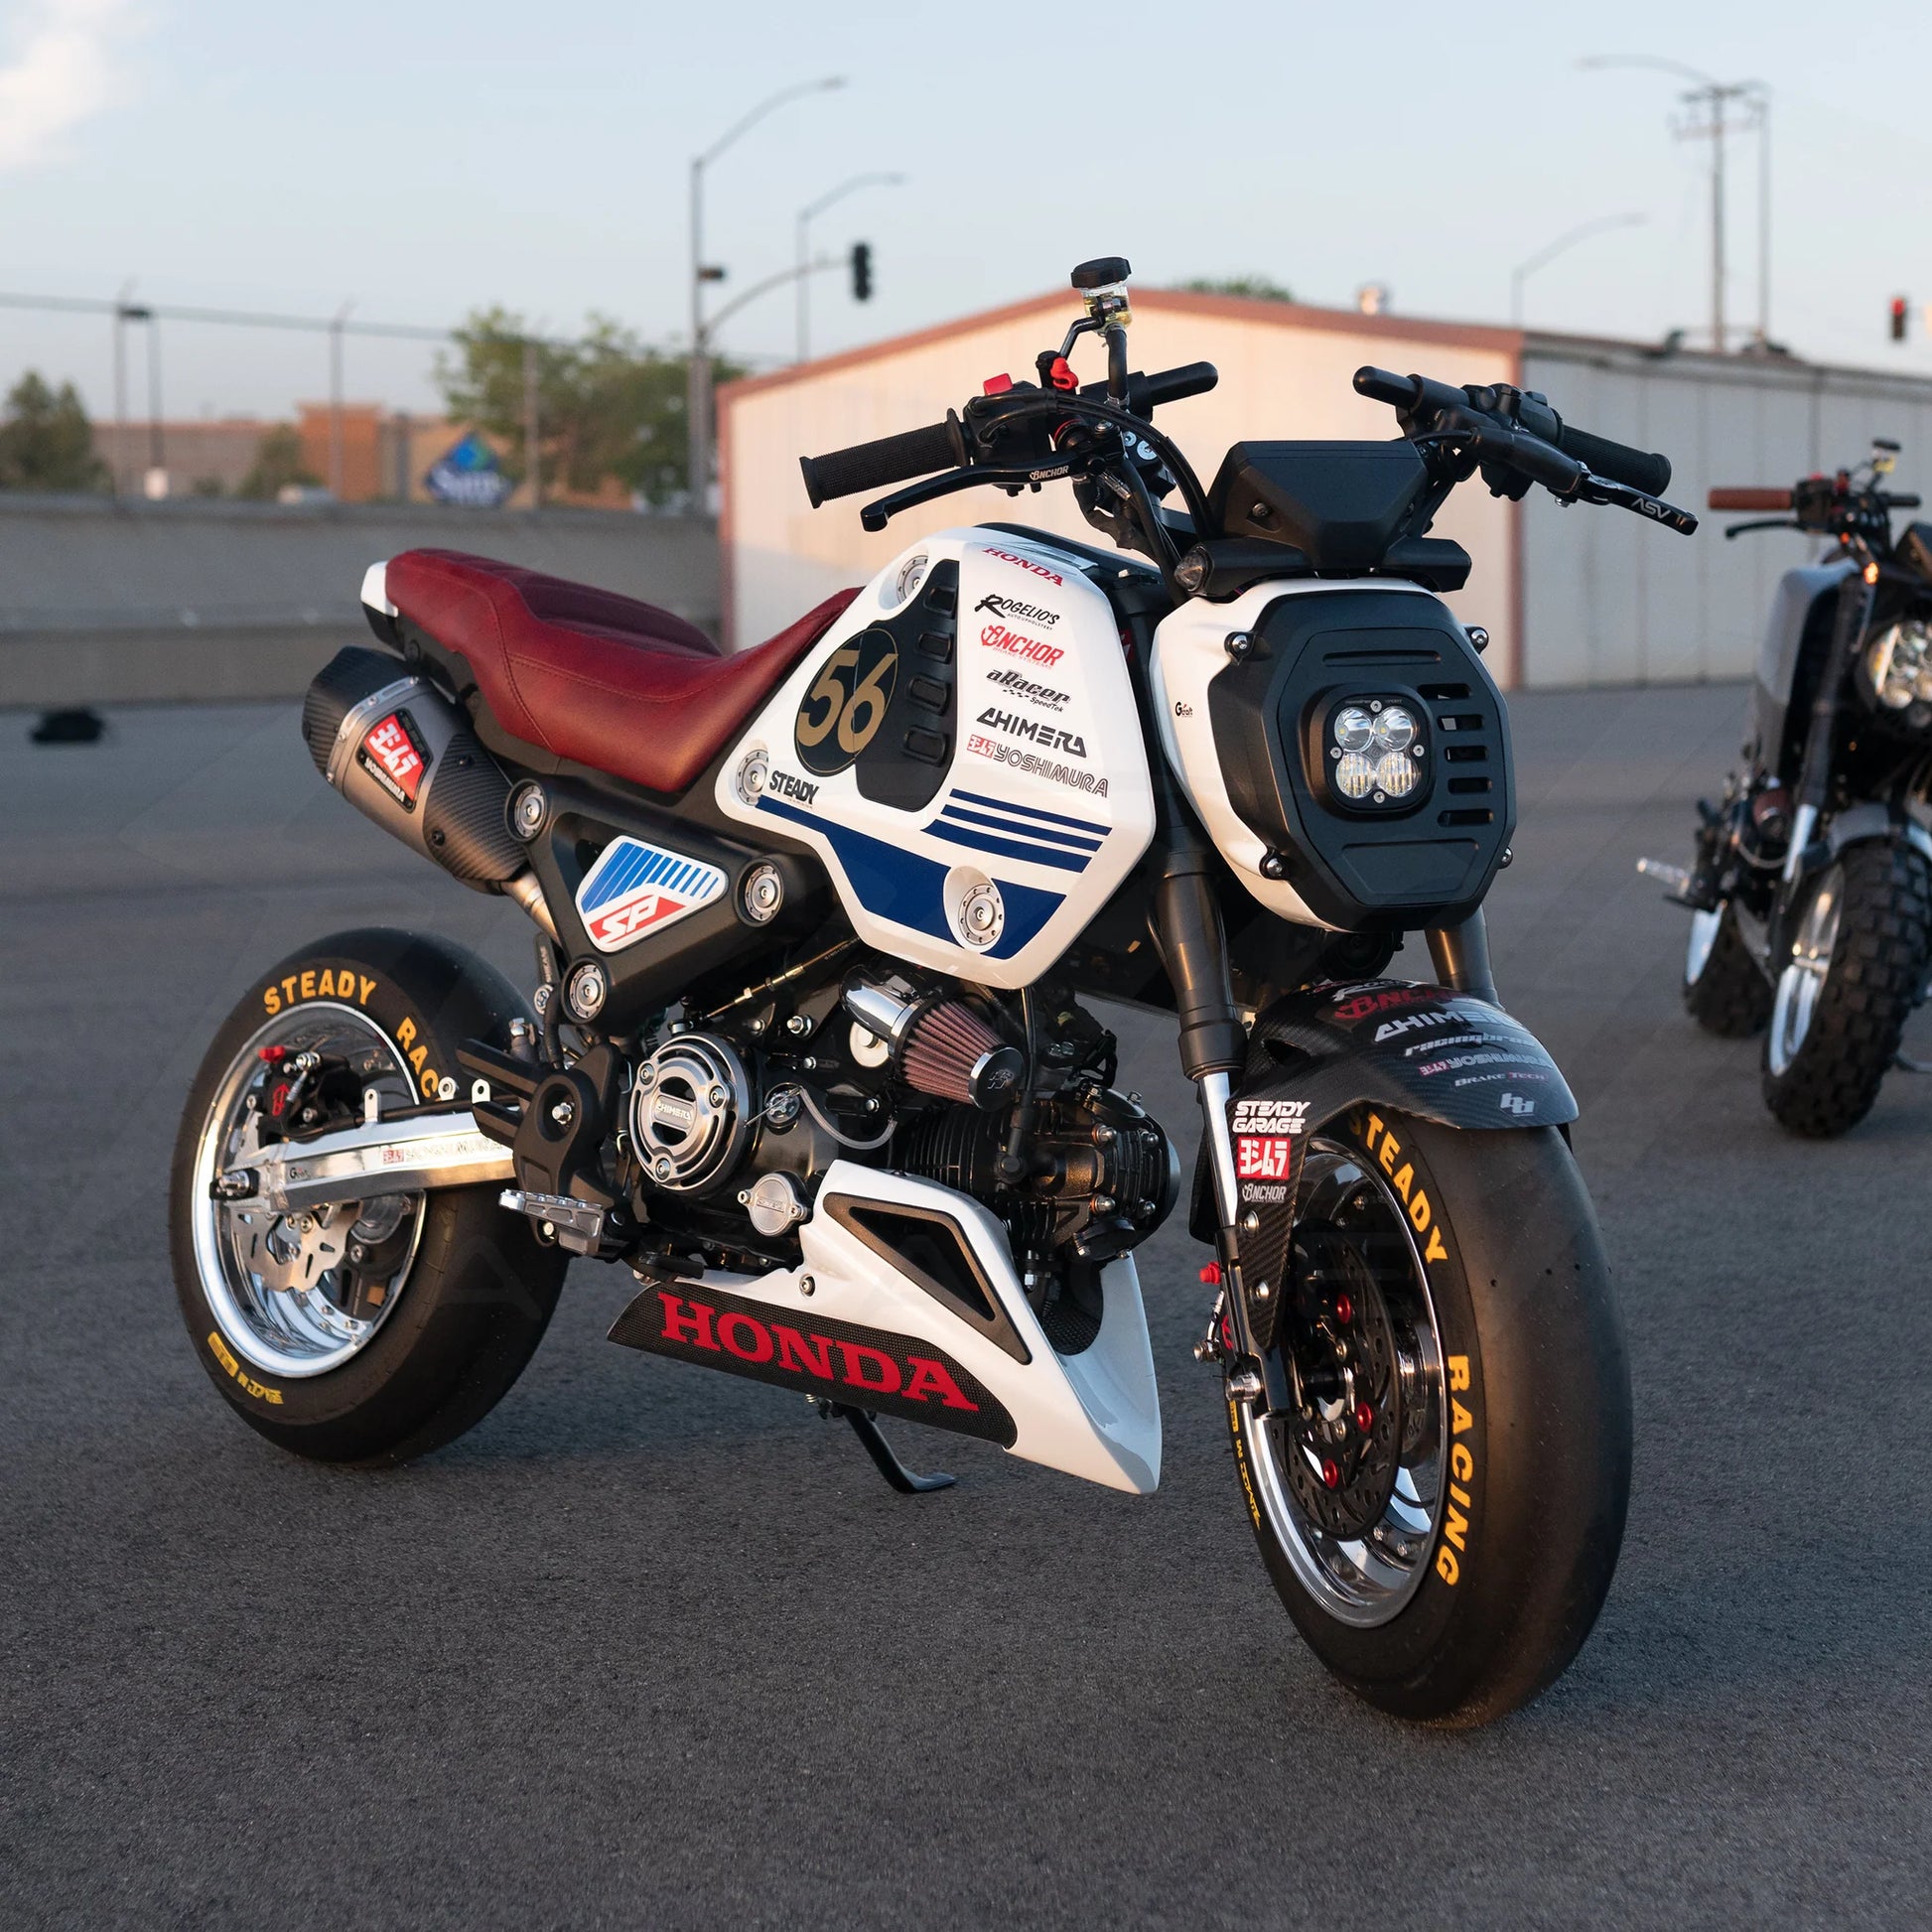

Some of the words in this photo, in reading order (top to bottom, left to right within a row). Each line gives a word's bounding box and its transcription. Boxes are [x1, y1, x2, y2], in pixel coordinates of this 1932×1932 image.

[1030, 465, 1069, 481] ANCHOR
[1631, 497, 1671, 518] ASV
[982, 547, 1064, 587] HONDA
[974, 594, 1060, 624] ROGELIO'S
[981, 624, 1064, 666] ANCHOR
[796, 649, 898, 754] 56
[986, 669, 1071, 704] aRacer
[1030, 697, 1063, 713] SpeedTek
[976, 707, 1087, 759] CHIMERA
[769, 770, 819, 804] STEADY
[993, 743, 1109, 798] YOSHIMURA
[264, 969, 376, 1015] STEADY
[397, 1017, 442, 1101] RAC
[1232, 1118, 1306, 1134] GARAGE
[1235, 1101, 1311, 1117] STEADY
[1242, 1183, 1287, 1202] ANCHOR
[657, 1291, 979, 1412] HONDA
[1437, 1355, 1473, 1587] RACING
